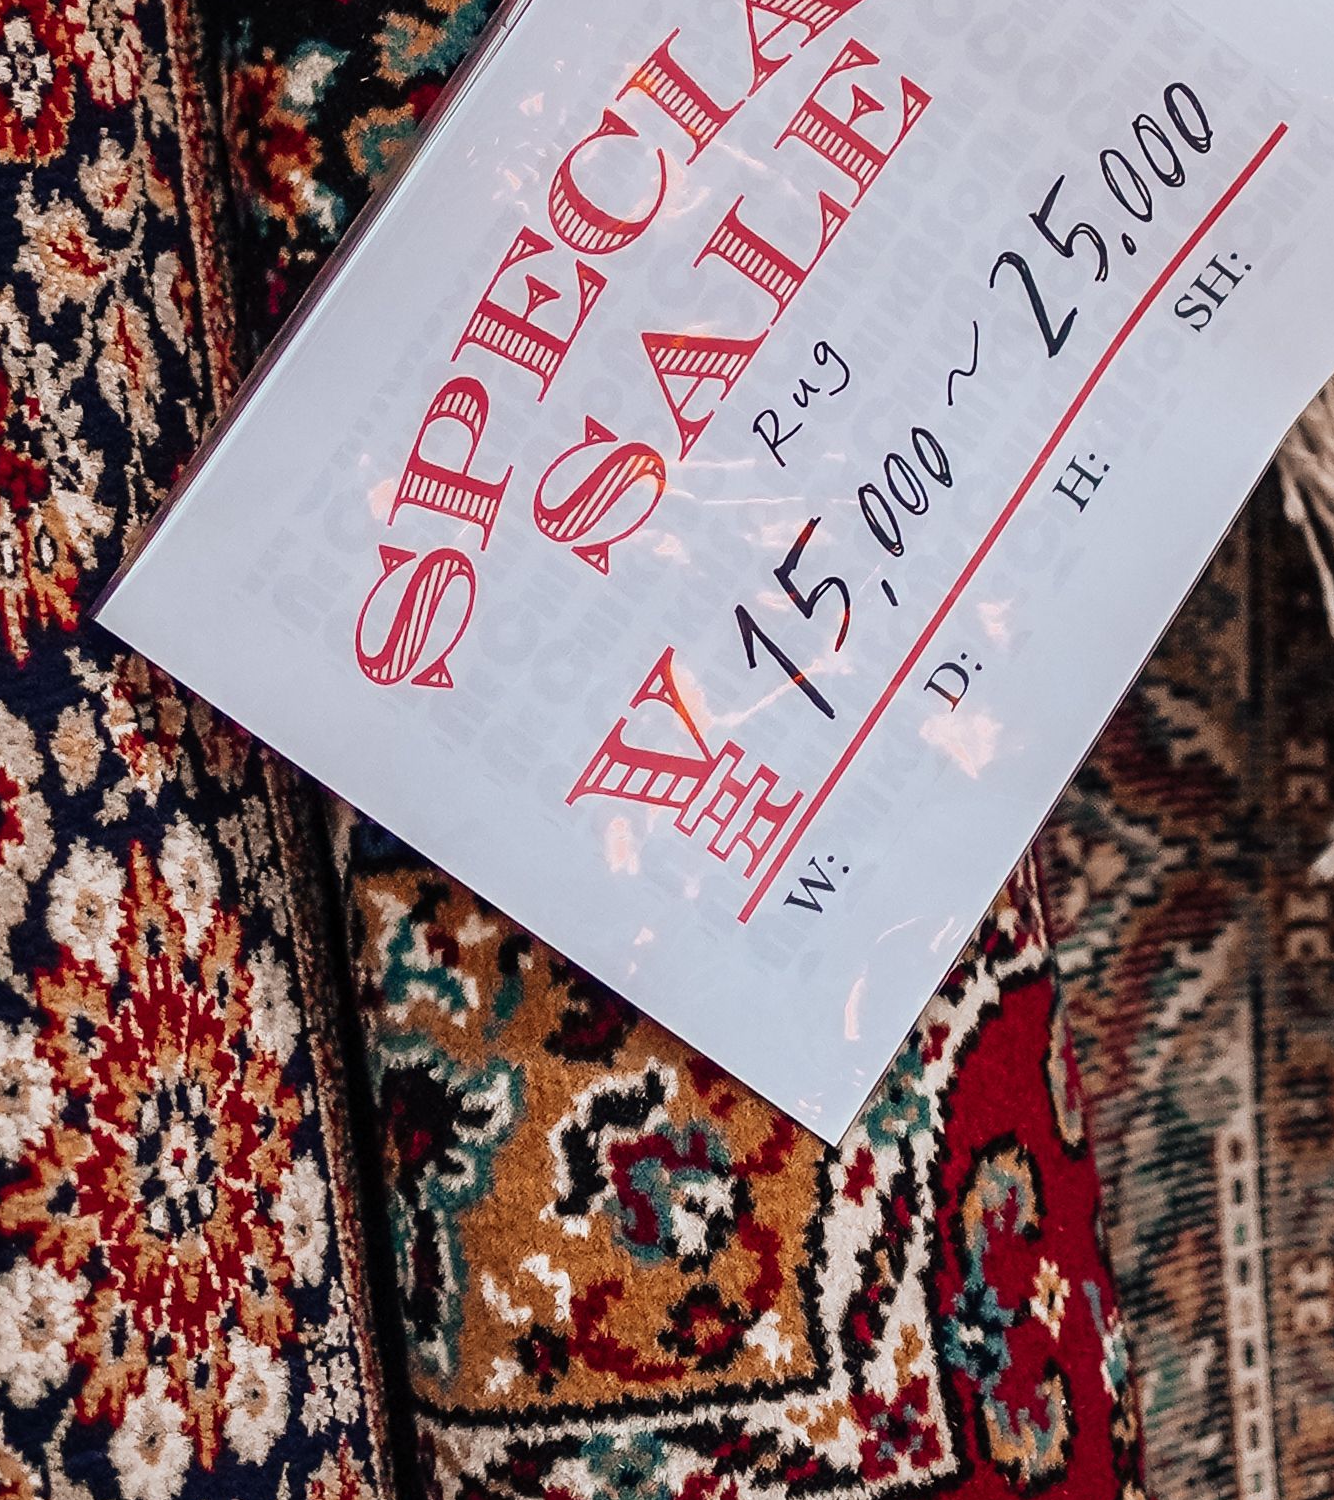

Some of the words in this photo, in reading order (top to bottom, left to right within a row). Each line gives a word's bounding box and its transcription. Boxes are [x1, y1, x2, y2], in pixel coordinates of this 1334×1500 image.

[533, 38, 933, 577] SALE
[752, 340, 852, 468] Rug
[565, 645, 807, 879] ¥
[735, 426, 954, 720] 15,000
[783, 848, 853, 915] W:
[923, 649, 985, 713] D:
[1052, 448, 1113, 514] H:
[1174, 247, 1255, 334] SH:
